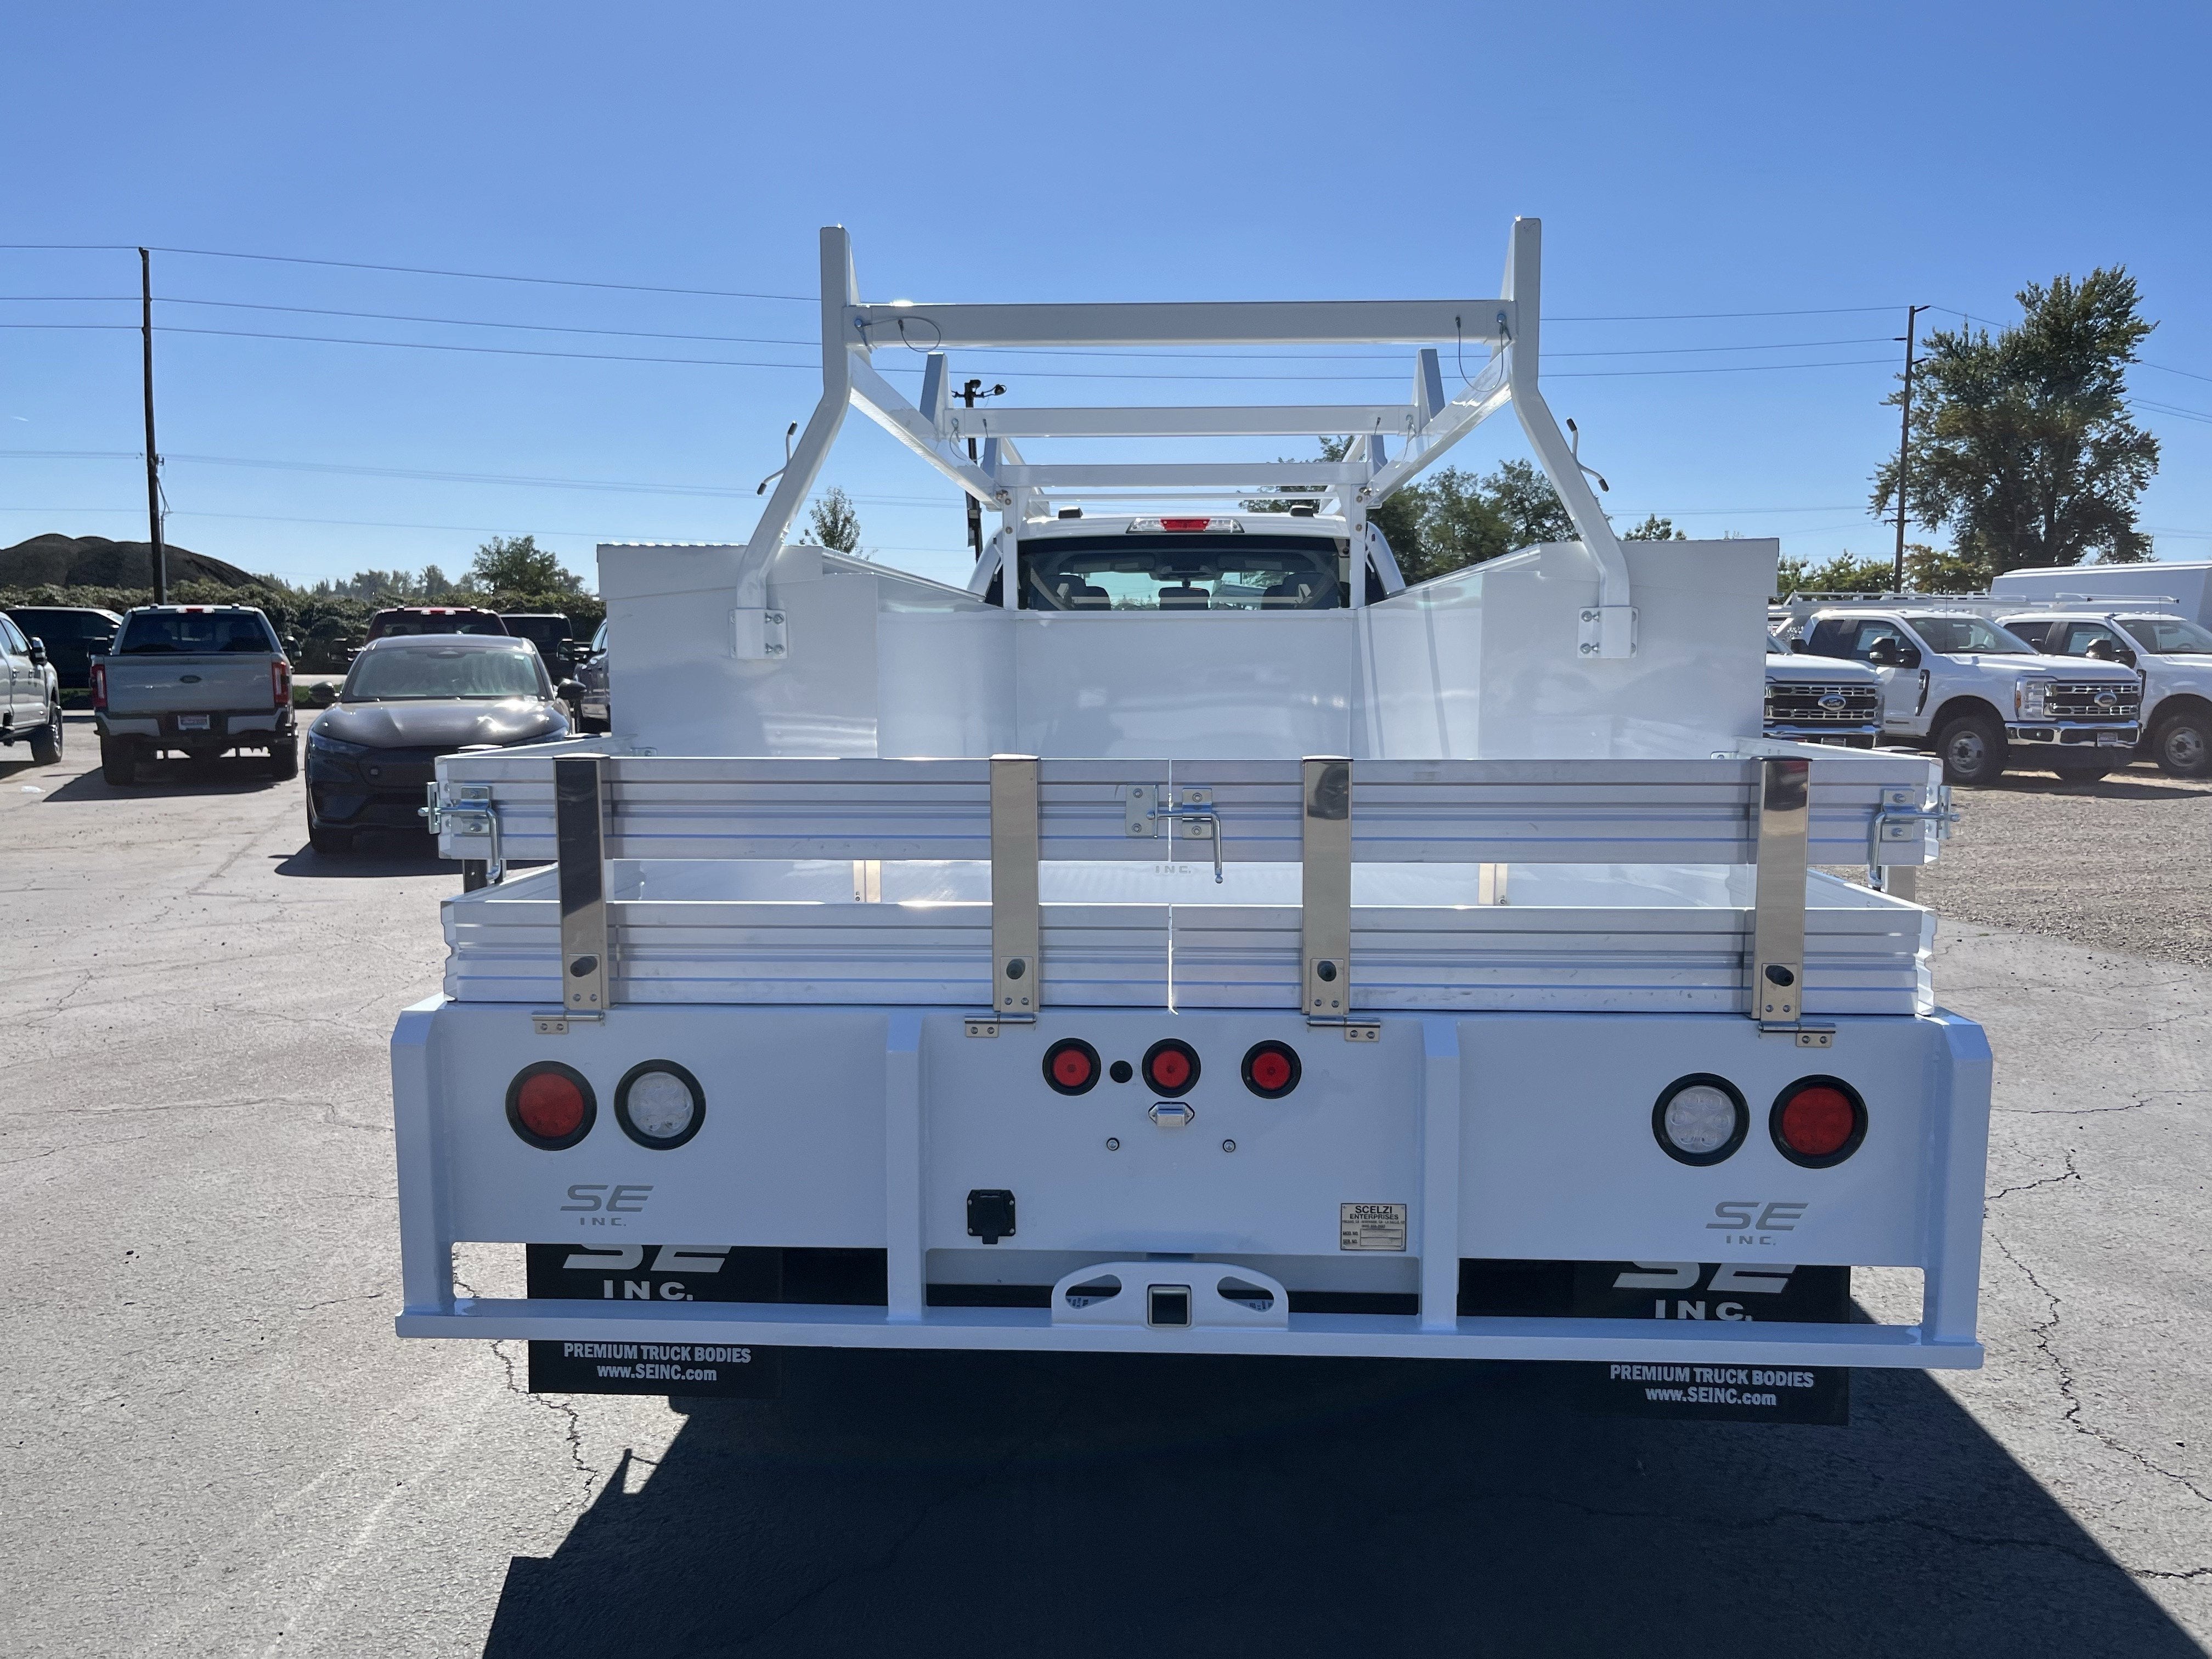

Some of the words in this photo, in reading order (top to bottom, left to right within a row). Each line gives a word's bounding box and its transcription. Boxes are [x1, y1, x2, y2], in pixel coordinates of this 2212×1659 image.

[560, 1184, 654, 1212] SE
[1355, 1205, 1392, 1214] SCELZI
[1705, 1201, 1808, 1231] SE
[580, 1217, 627, 1226] INC.
[1726, 1235, 1776, 1246] INC.
[603, 1279, 693, 1301] INC.
[1655, 1299, 1753, 1321] INC.
[564, 1343, 638, 1359] PREMIUM
[640, 1345, 691, 1362] TRUCK
[694, 1346, 752, 1363] BODIES
[597, 1363, 717, 1381] www.SEINC.com
[1610, 1364, 1690, 1382] PREMIUM
[1693, 1367, 1749, 1385] TRUCK
[1752, 1370, 1814, 1388] BODIES
[1645, 1386, 1777, 1406] www.SEINC.com
